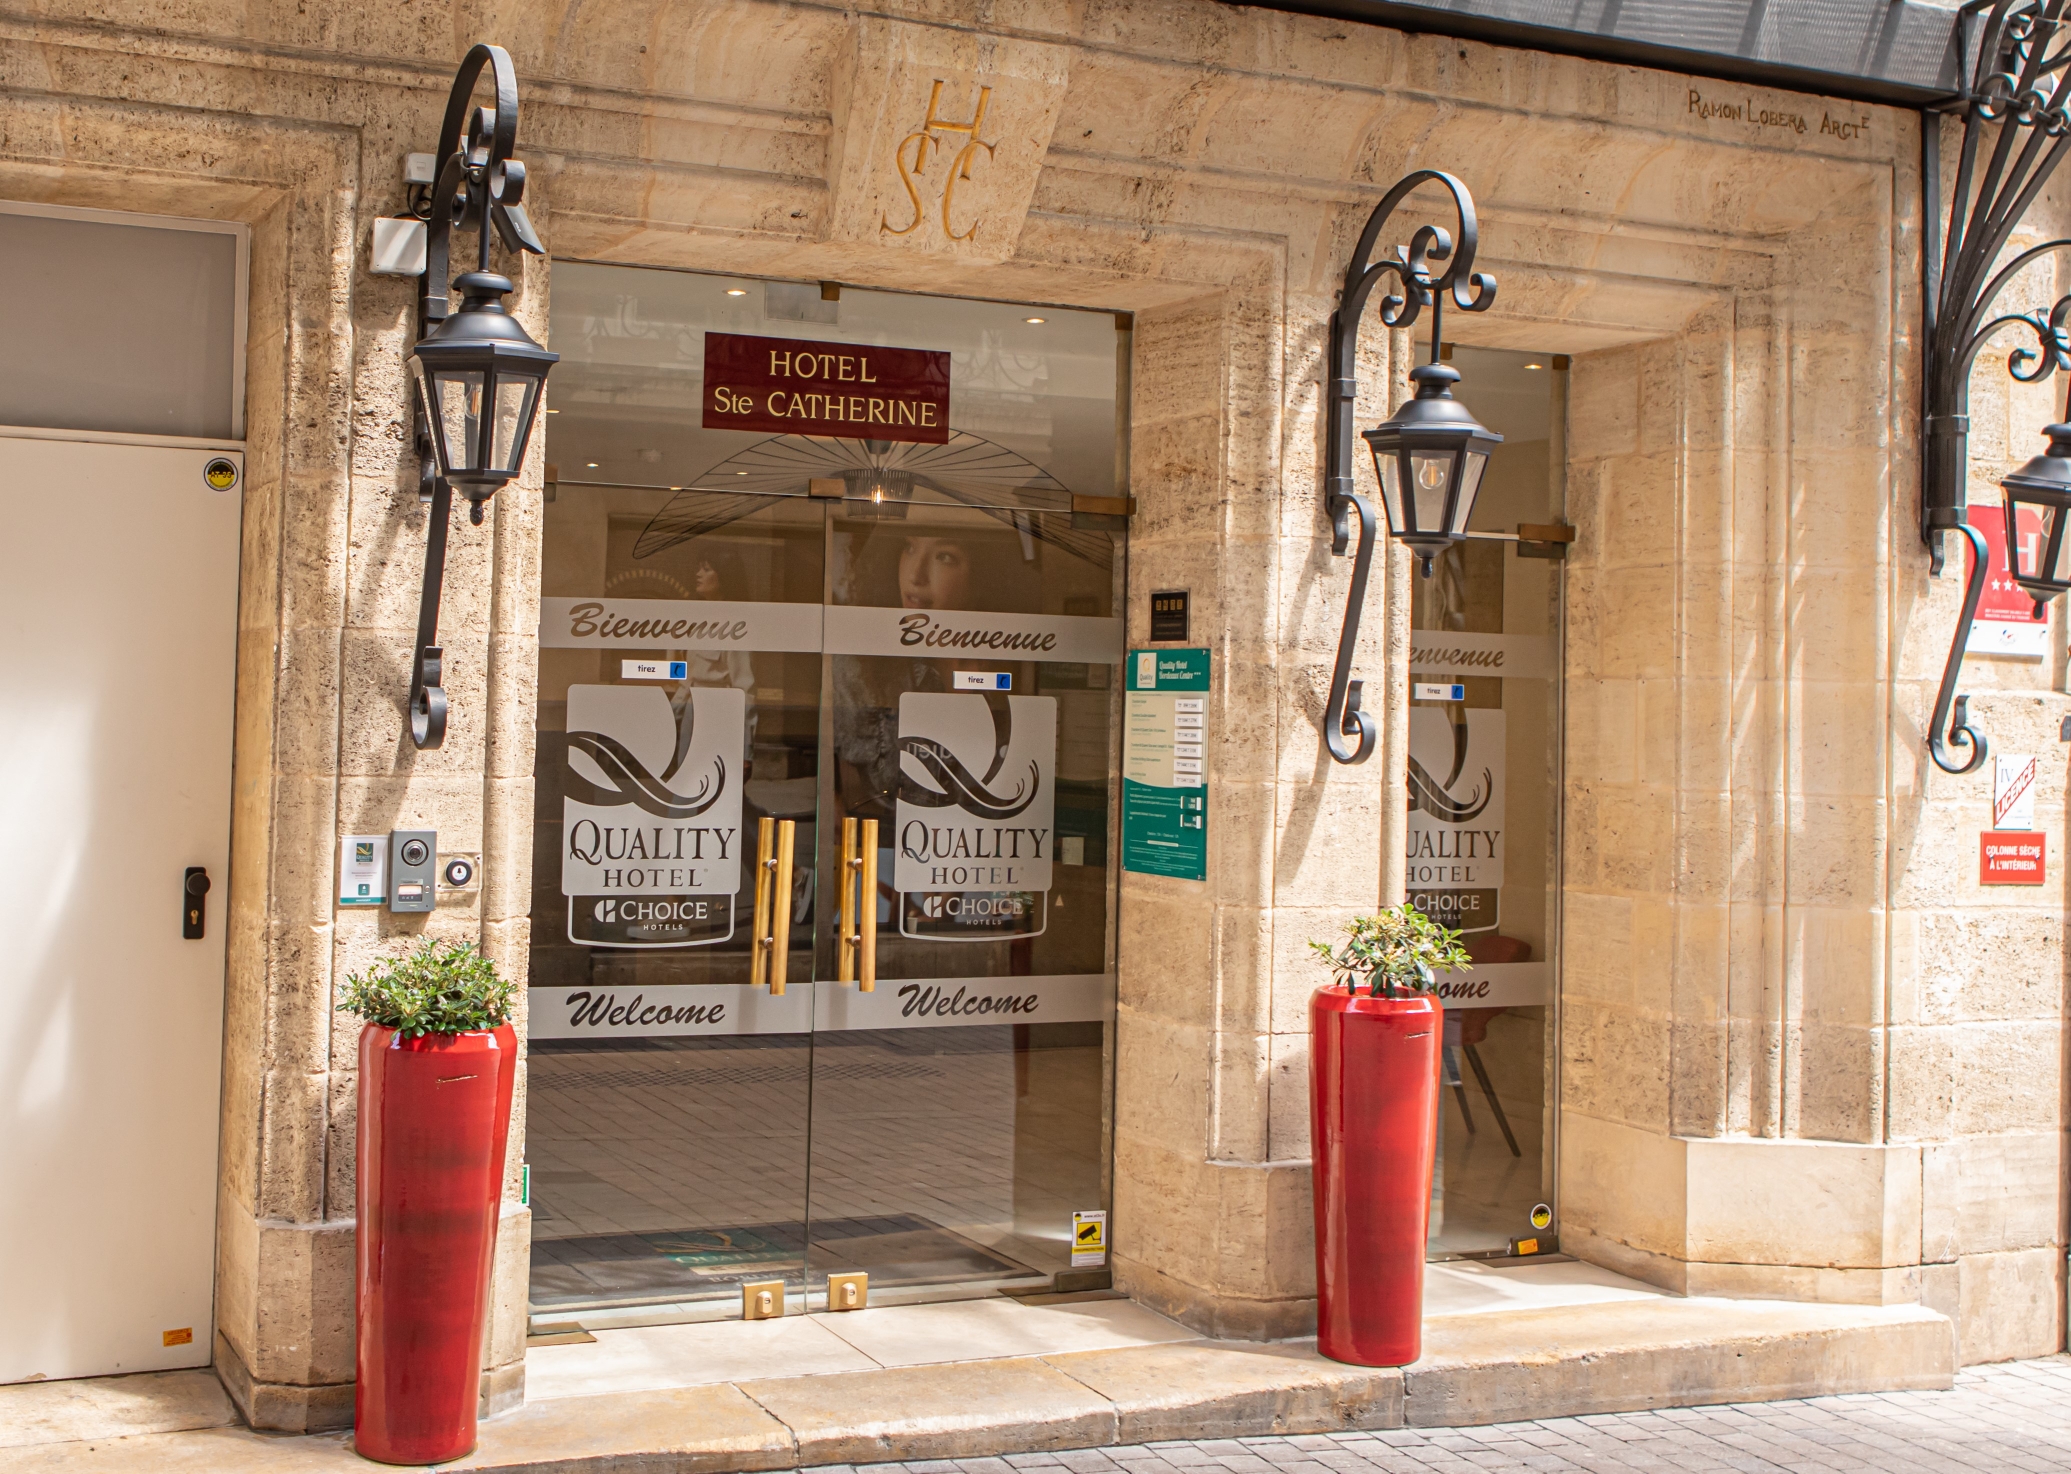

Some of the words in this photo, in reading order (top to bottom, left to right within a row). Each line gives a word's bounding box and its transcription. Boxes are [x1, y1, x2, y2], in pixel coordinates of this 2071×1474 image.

[1688, 89, 1741, 120] RAMON
[1747, 99, 1808, 134] LOBERA
[769, 350, 877, 383] HOTEL
[714, 387, 753, 414] Ste
[767, 391, 938, 427] CATHERINE
[568, 602, 748, 640] Bienvenue
[899, 613, 1057, 651] Bienvenue
[637, 664, 656, 673] tirez
[1410, 647, 1505, 667] envenue
[968, 675, 984, 684] tirez
[1427, 687, 1441, 695] tirez
[2001, 768, 2013, 783] IV
[1996, 759, 2035, 821] LICENCE
[569, 819, 736, 866] QUALITY
[901, 820, 1049, 864] QUALITY
[1406, 830, 1500, 858] UALITY
[1985, 845, 2018, 856] COLONNE
[602, 869, 702, 887] HOTEL
[930, 866, 1019, 885] HOTEL
[620, 900, 708, 920] CHOICE
[945, 897, 1023, 915] CHOICE
[1414, 893, 1480, 910] CHOICE
[566, 991, 725, 1027] Welcome
[898, 983, 1039, 1017] Welcome
